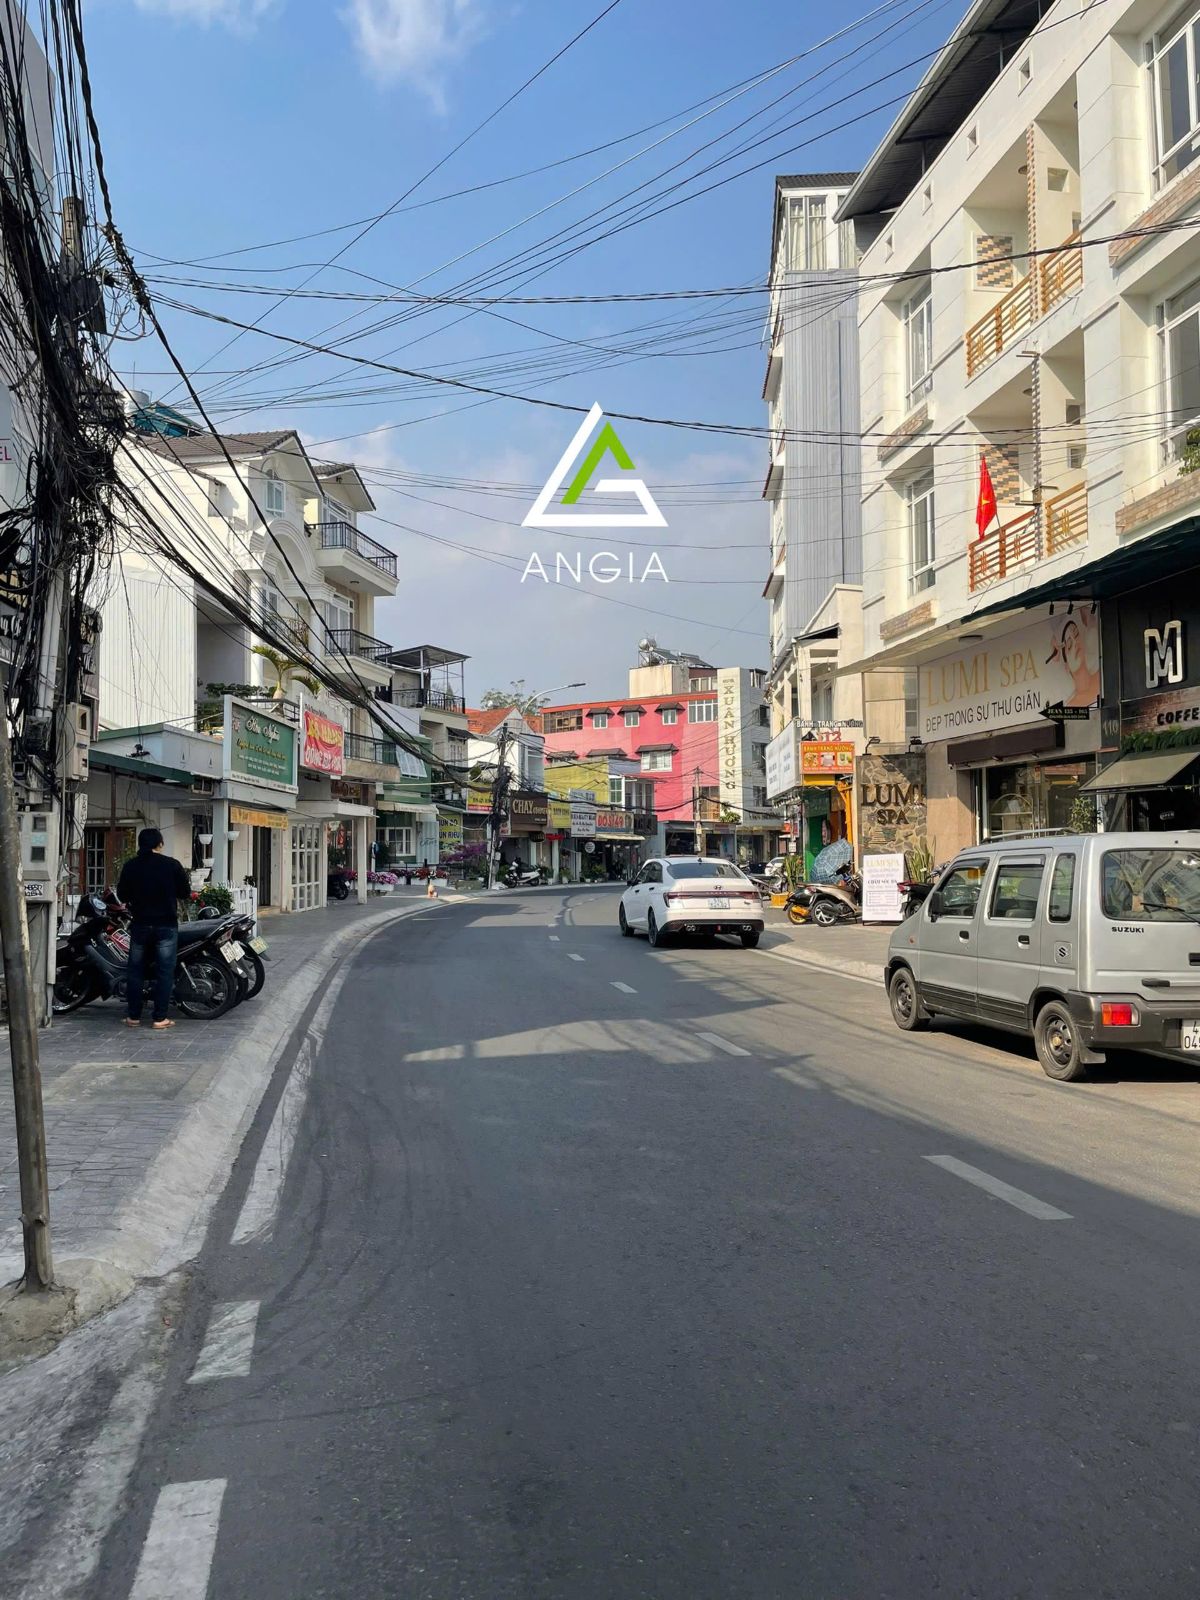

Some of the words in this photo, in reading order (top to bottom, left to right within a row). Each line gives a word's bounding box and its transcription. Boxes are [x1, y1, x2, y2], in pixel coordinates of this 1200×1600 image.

[926, 652, 991, 707] LUMI
[1000, 648, 1040, 688] SPA
[723, 686, 735, 730] XUÂN
[944, 708, 974, 728] TRONG
[991, 696, 1013, 718] THƯ
[1014, 690, 1041, 713] GIÃN
[861, 783, 925, 806] LUMI
[877, 809, 909, 826] SPA
